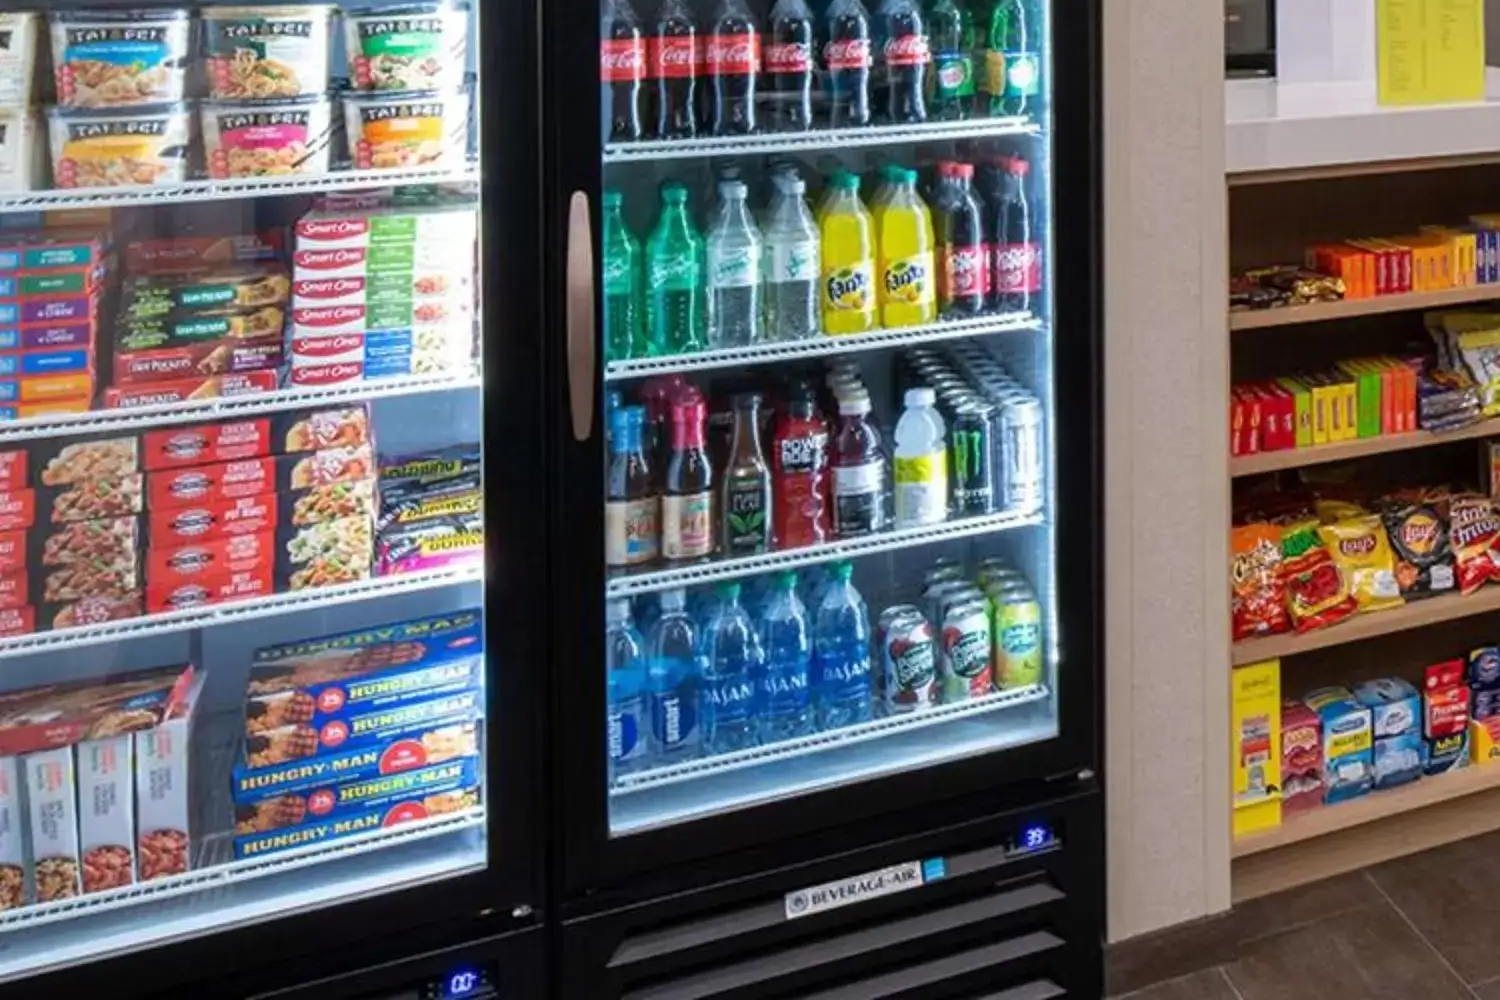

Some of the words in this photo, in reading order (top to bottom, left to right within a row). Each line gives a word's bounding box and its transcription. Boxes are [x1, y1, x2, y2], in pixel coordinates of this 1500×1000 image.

[301, 252, 333, 264] Smart
[335, 250, 362, 262] Ones
[299, 280, 332, 293] Smart
[333, 279, 361, 290] Ones
[299, 309, 332, 322] Smart
[333, 306, 361, 319] Ones
[299, 337, 332, 350] Smart
[333, 335, 361, 348] Ones
[297, 366, 330, 379] Smart
[331, 364, 359, 377] Ones
[810, 867, 918, 906] BEVERAGE-AIR
